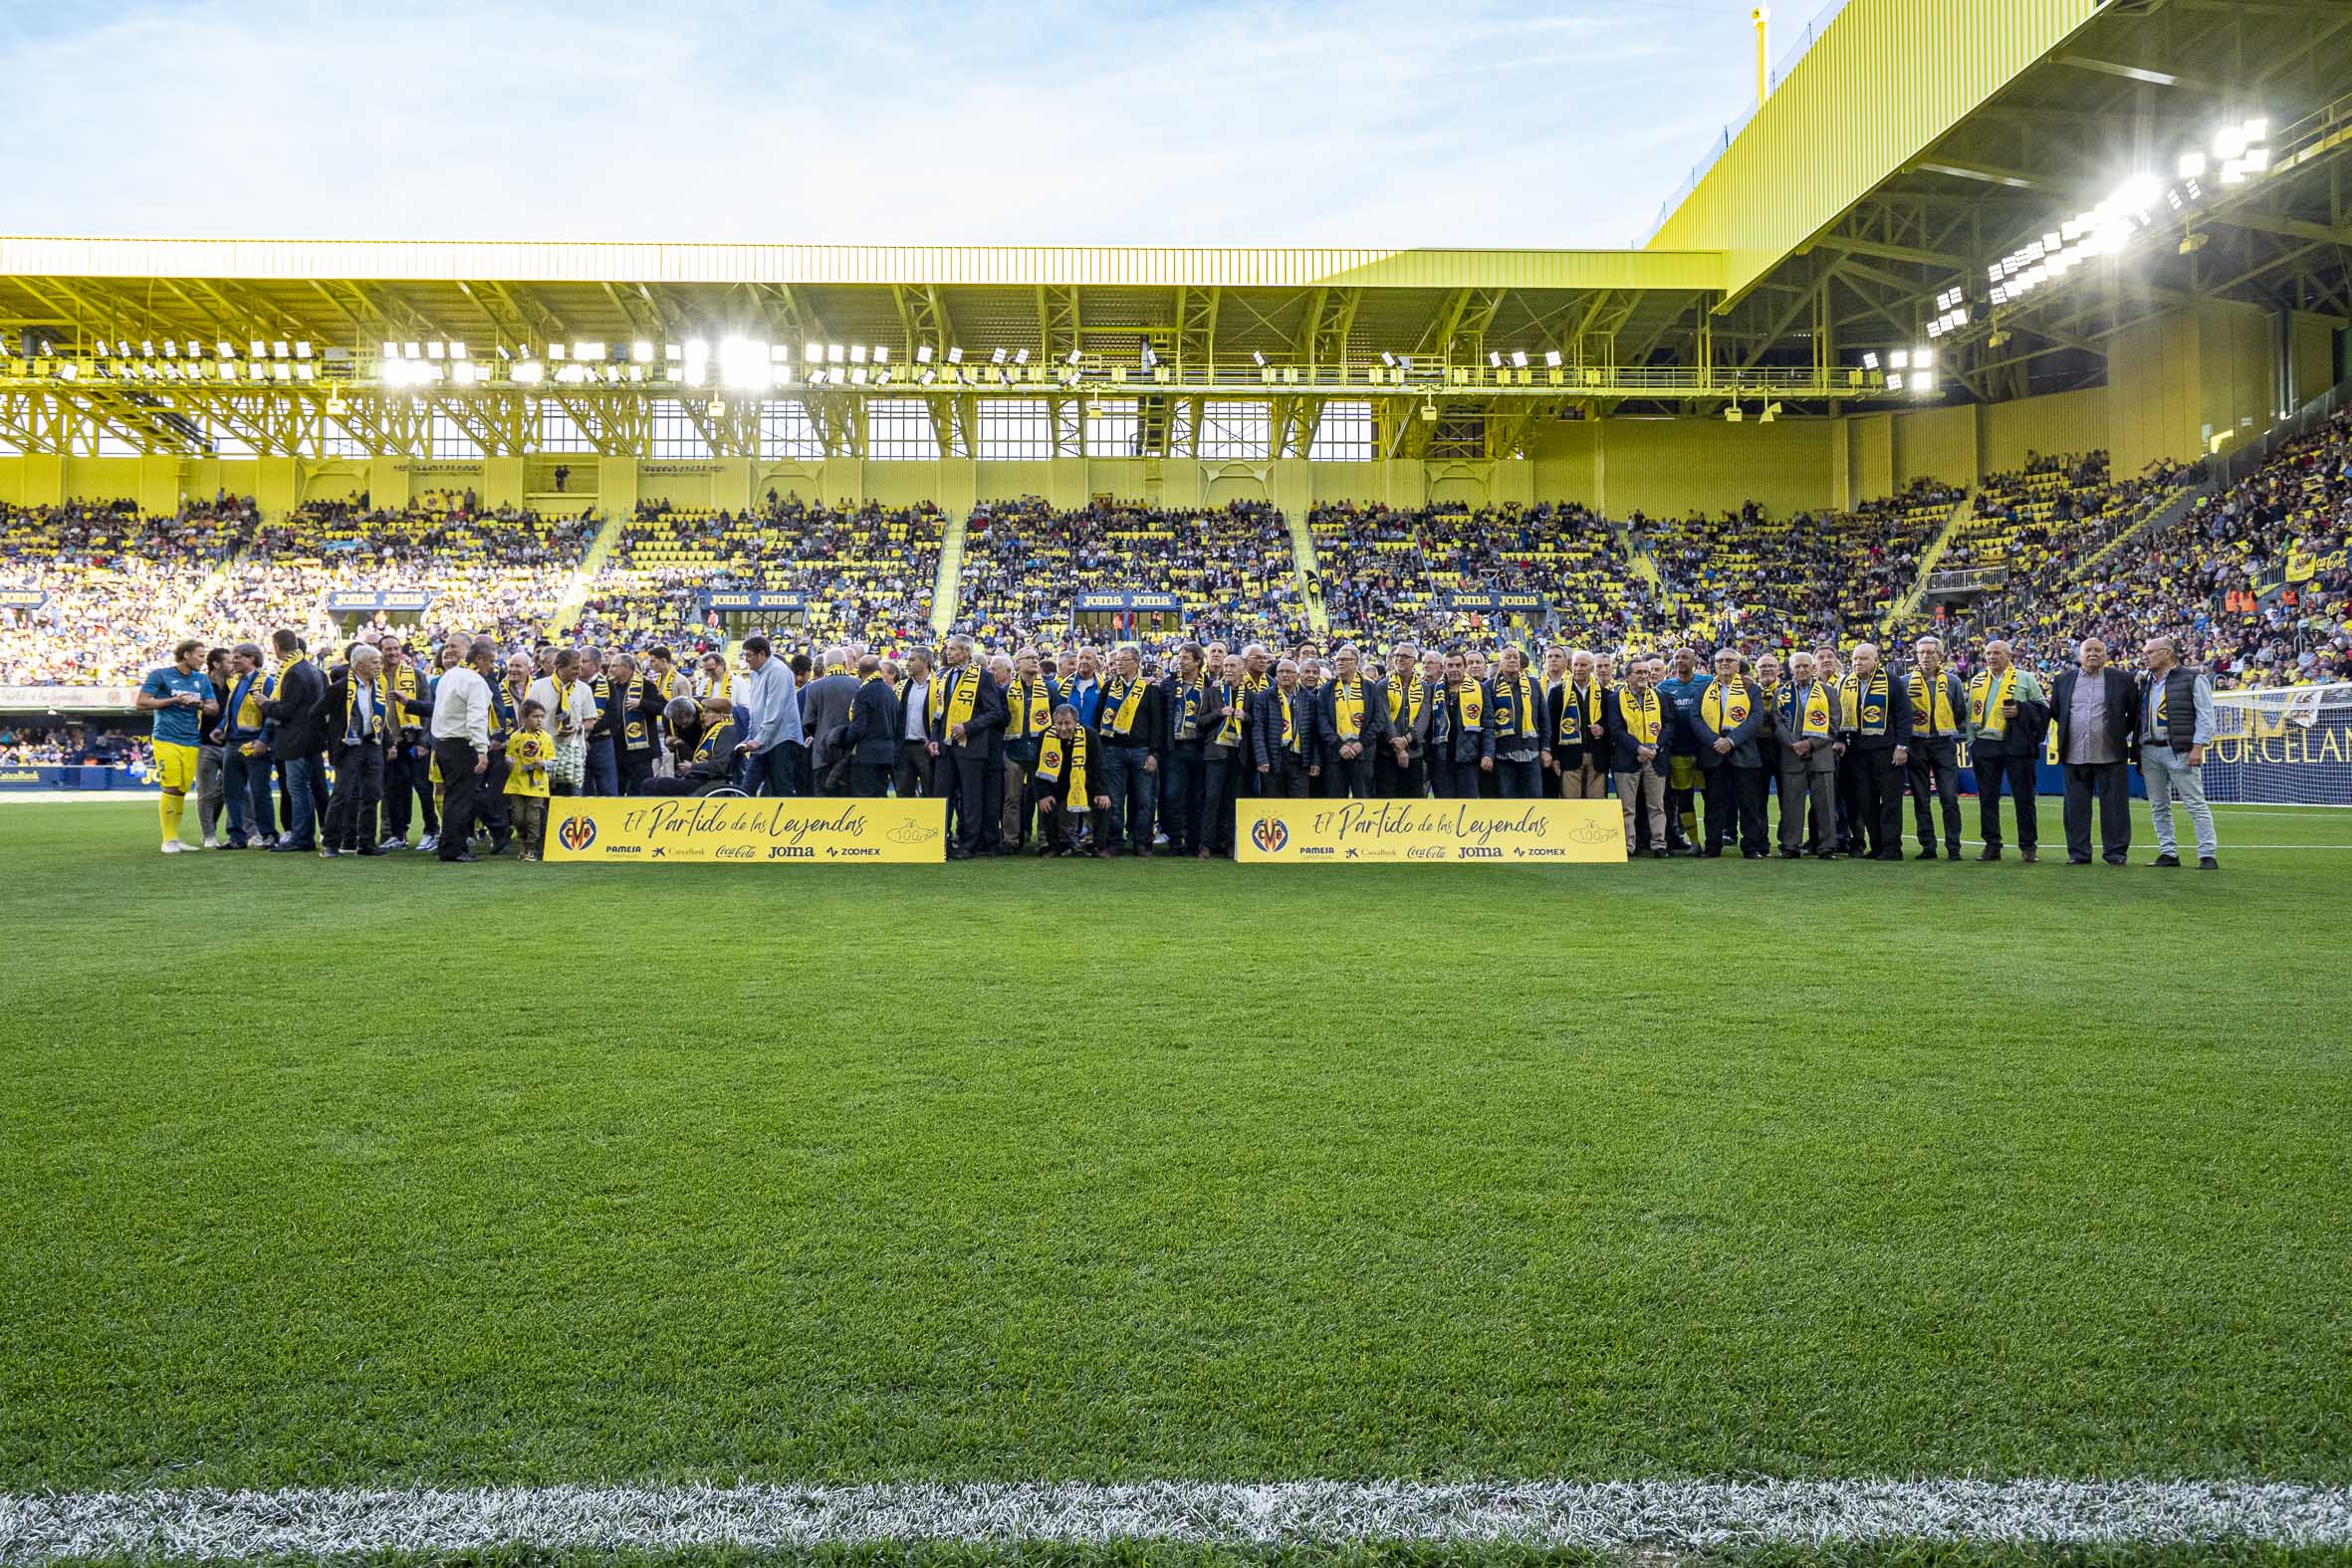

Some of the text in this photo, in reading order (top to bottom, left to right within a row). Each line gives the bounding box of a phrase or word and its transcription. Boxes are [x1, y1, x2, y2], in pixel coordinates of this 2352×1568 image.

[623, 799, 868, 844] El Partido de las Leyendas
[1313, 801, 1548, 845] El Partido de las Leyendas
